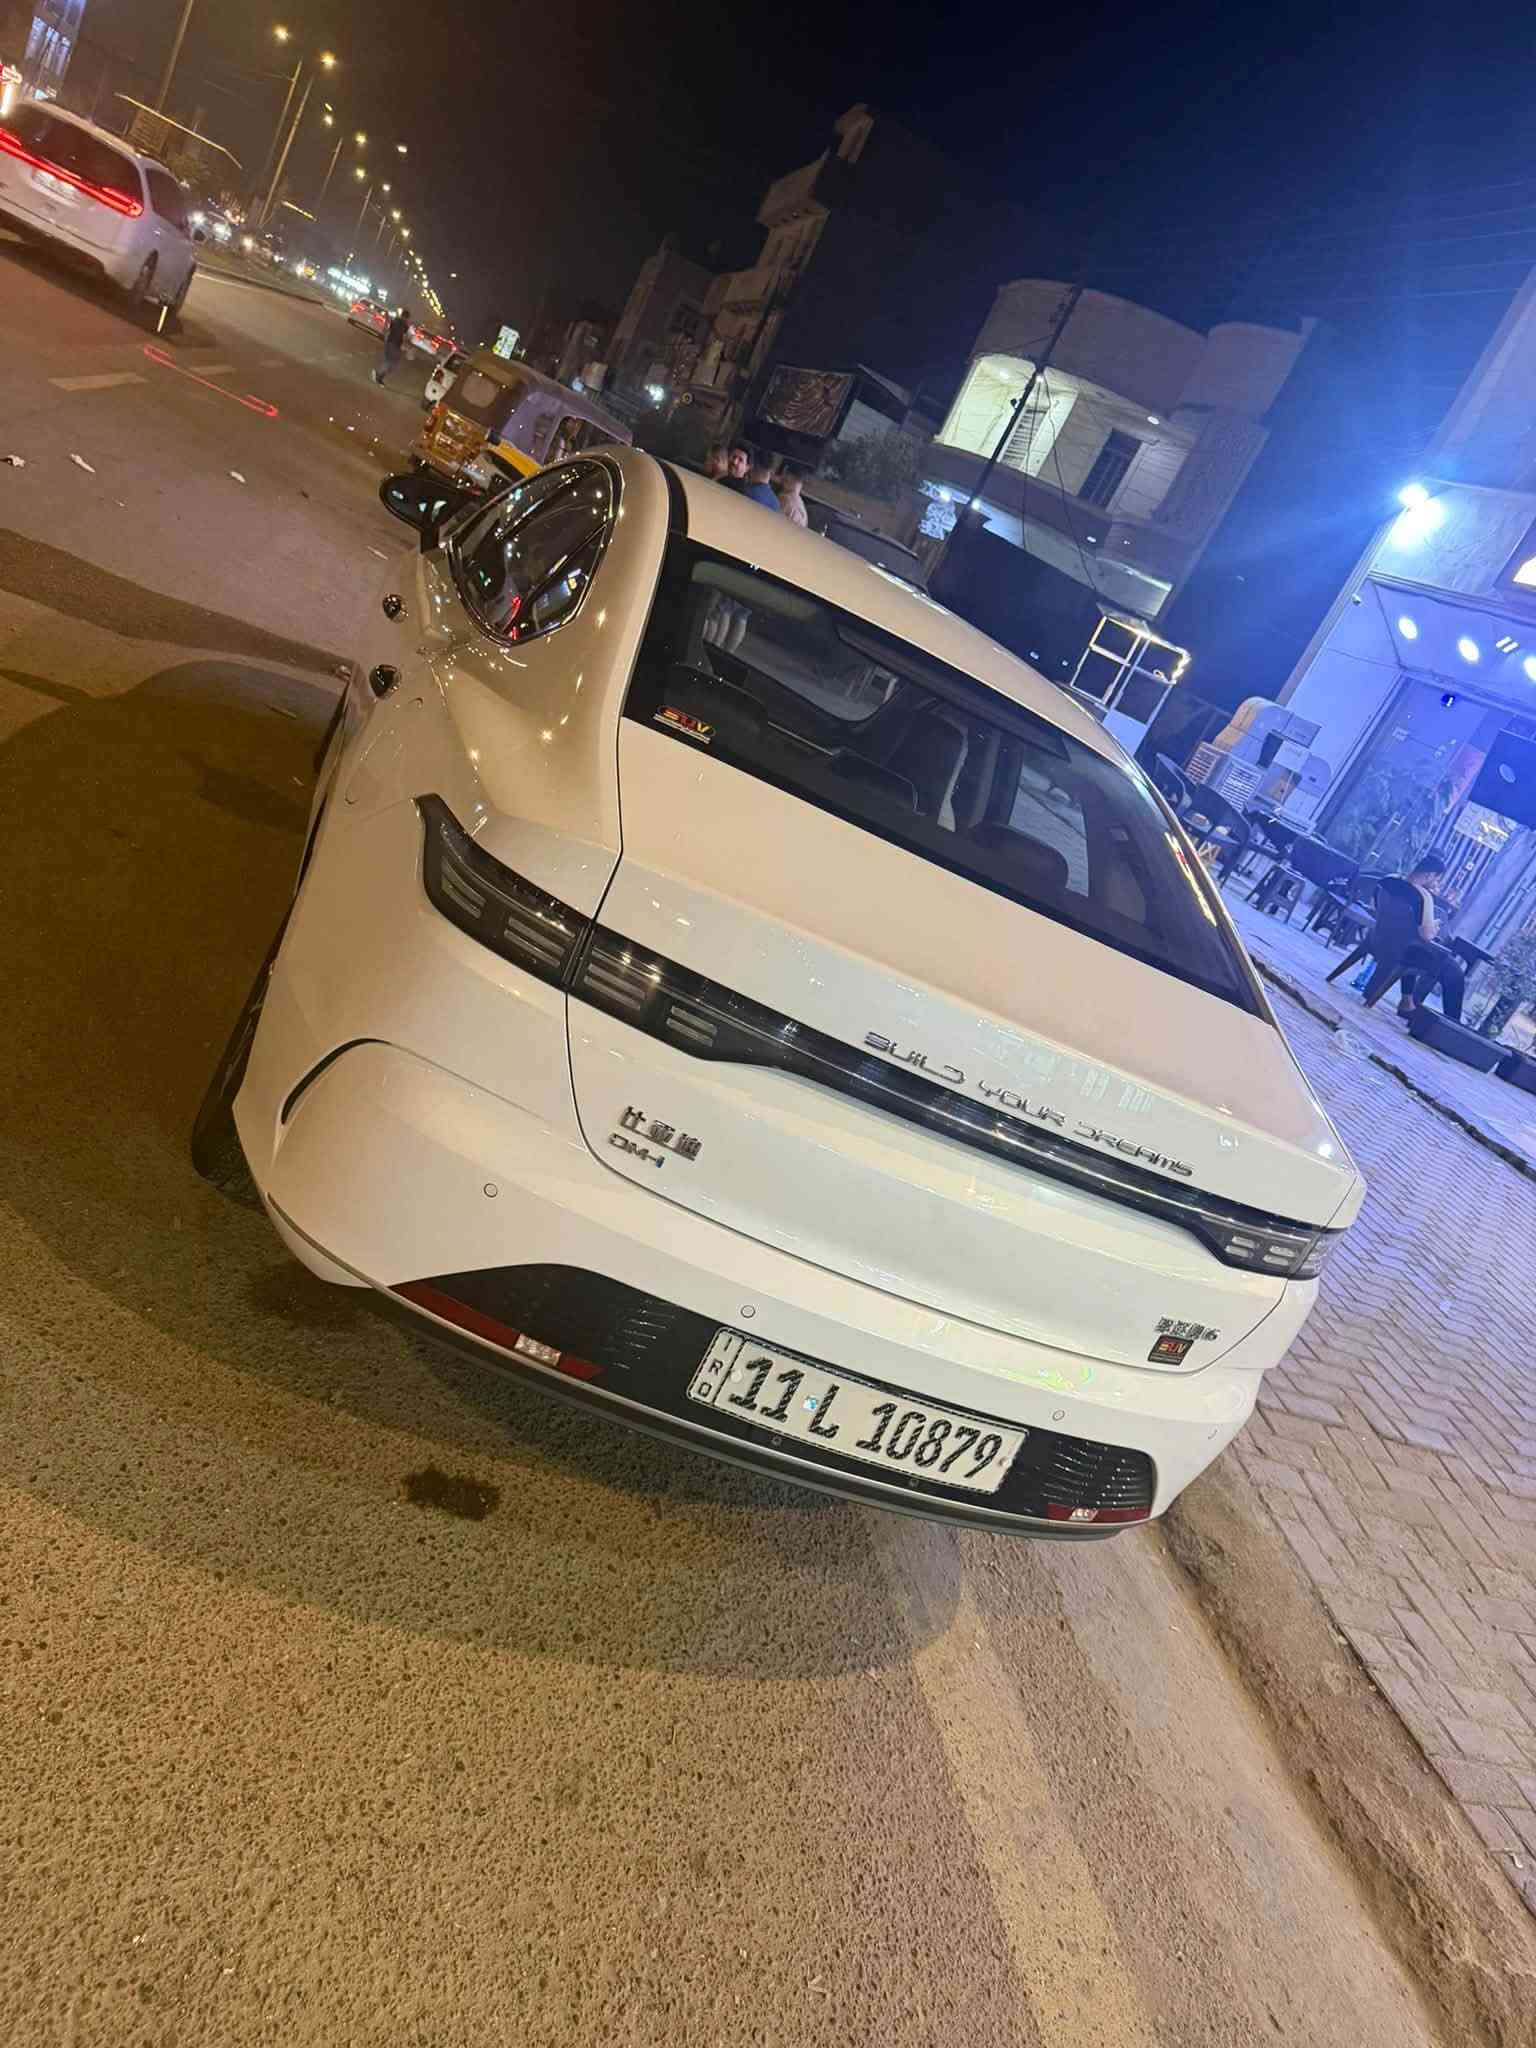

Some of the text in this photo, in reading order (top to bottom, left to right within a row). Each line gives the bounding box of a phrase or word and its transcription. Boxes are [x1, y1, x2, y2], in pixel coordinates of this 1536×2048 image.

[864, 1031, 1194, 1177] BUILD YOUR DREAMS
[729, 1357, 1003, 1478] 11 L 10879
